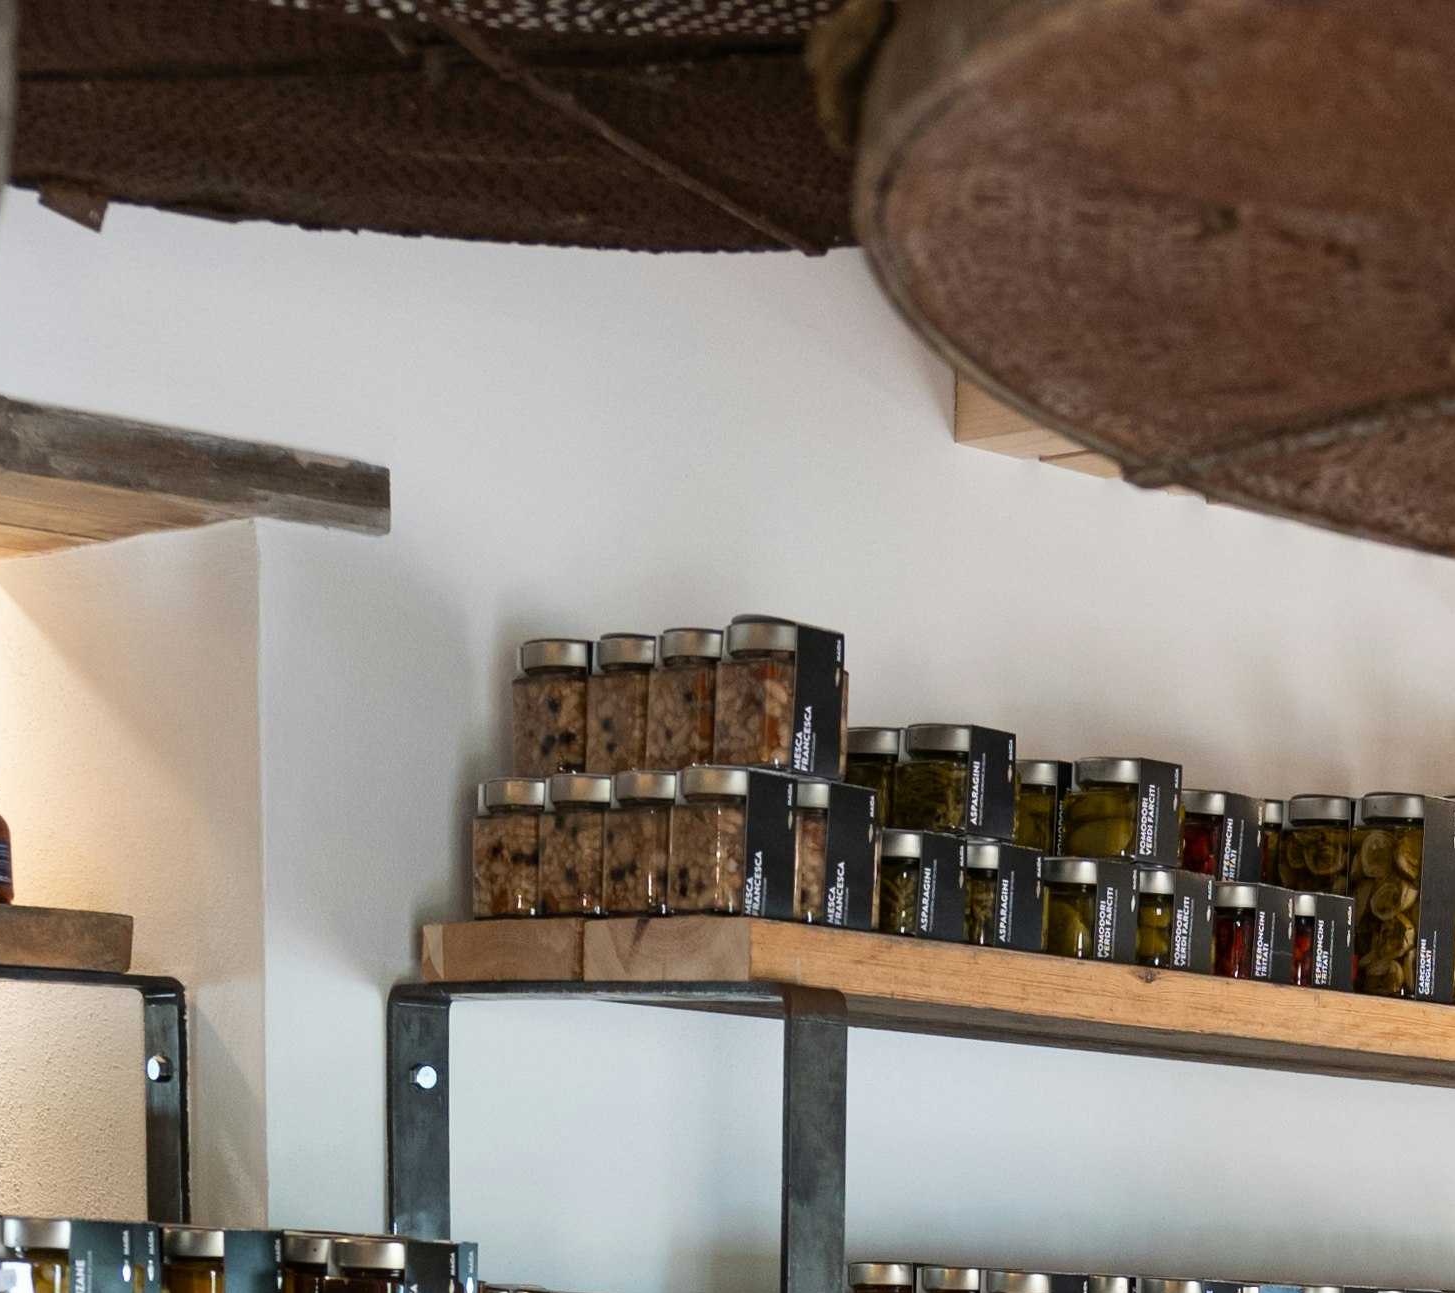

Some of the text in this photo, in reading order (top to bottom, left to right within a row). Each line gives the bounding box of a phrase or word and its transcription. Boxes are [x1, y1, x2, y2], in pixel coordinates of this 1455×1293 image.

[794, 731, 803, 771] MESCA
[801, 706, 813, 771] FRANCESCA
[970, 761, 981, 825] ASPARAGINI
[1139, 798, 1149, 855] POMODORI
[828, 887, 836, 922] MESCA
[835, 861, 845, 925] FRANCESCA
[998, 879, 1009, 942] ASPARAGINI
[1106, 886, 1114, 928] FARCITI
[1098, 900, 1107, 957] POMODORI
[1255, 911, 1266, 976] PEPERONCINI
[1261, 943, 1270, 977] TRITATI
[1418, 938, 1427, 994] CARCIOFINI
